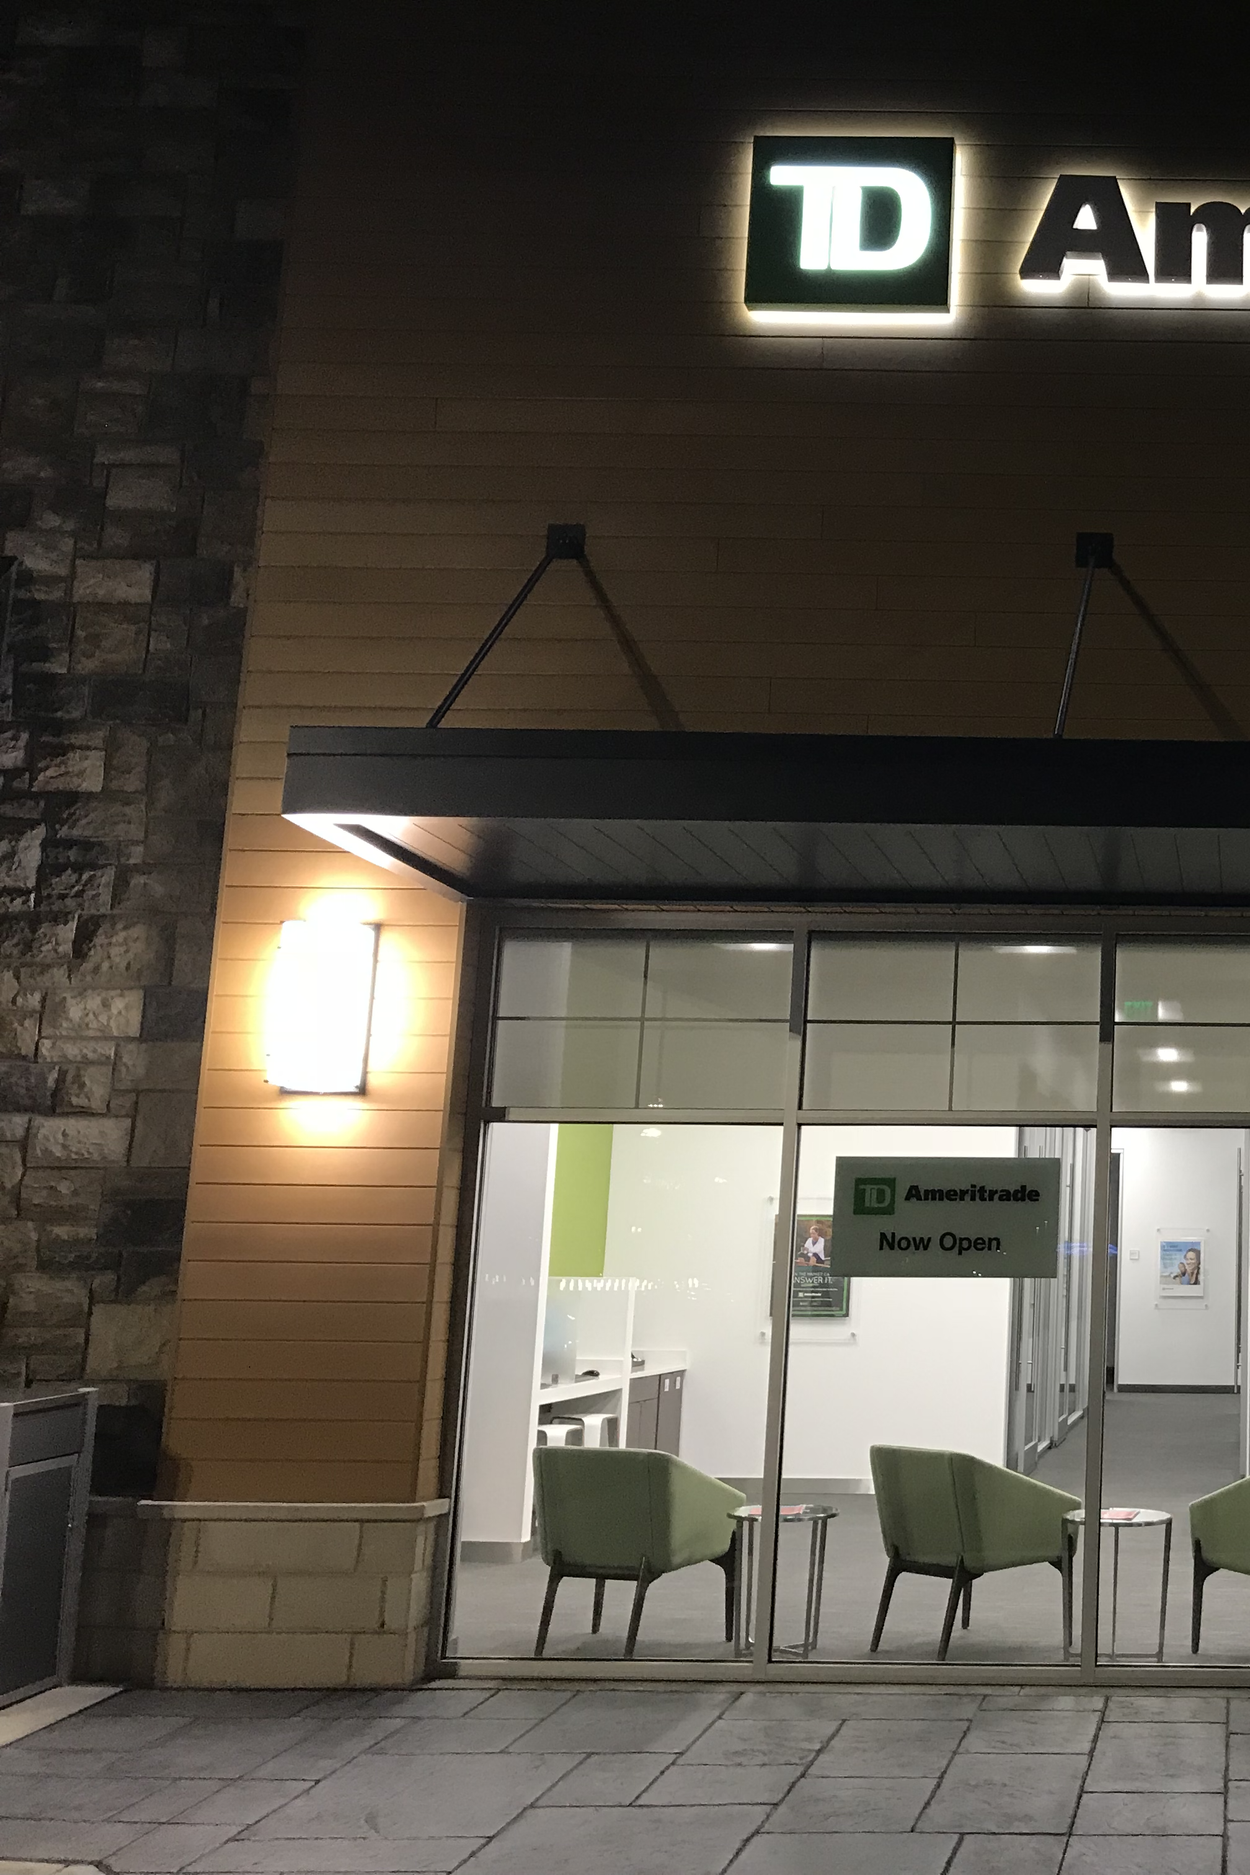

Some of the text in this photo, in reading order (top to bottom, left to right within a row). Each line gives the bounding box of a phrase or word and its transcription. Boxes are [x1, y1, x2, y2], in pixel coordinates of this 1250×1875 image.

[767, 165, 934, 272] TD
[858, 1184, 1041, 1208] TD Ameritrade
[879, 1231, 1001, 1255] Now Open
[793, 1276, 823, 1284] NSWER
